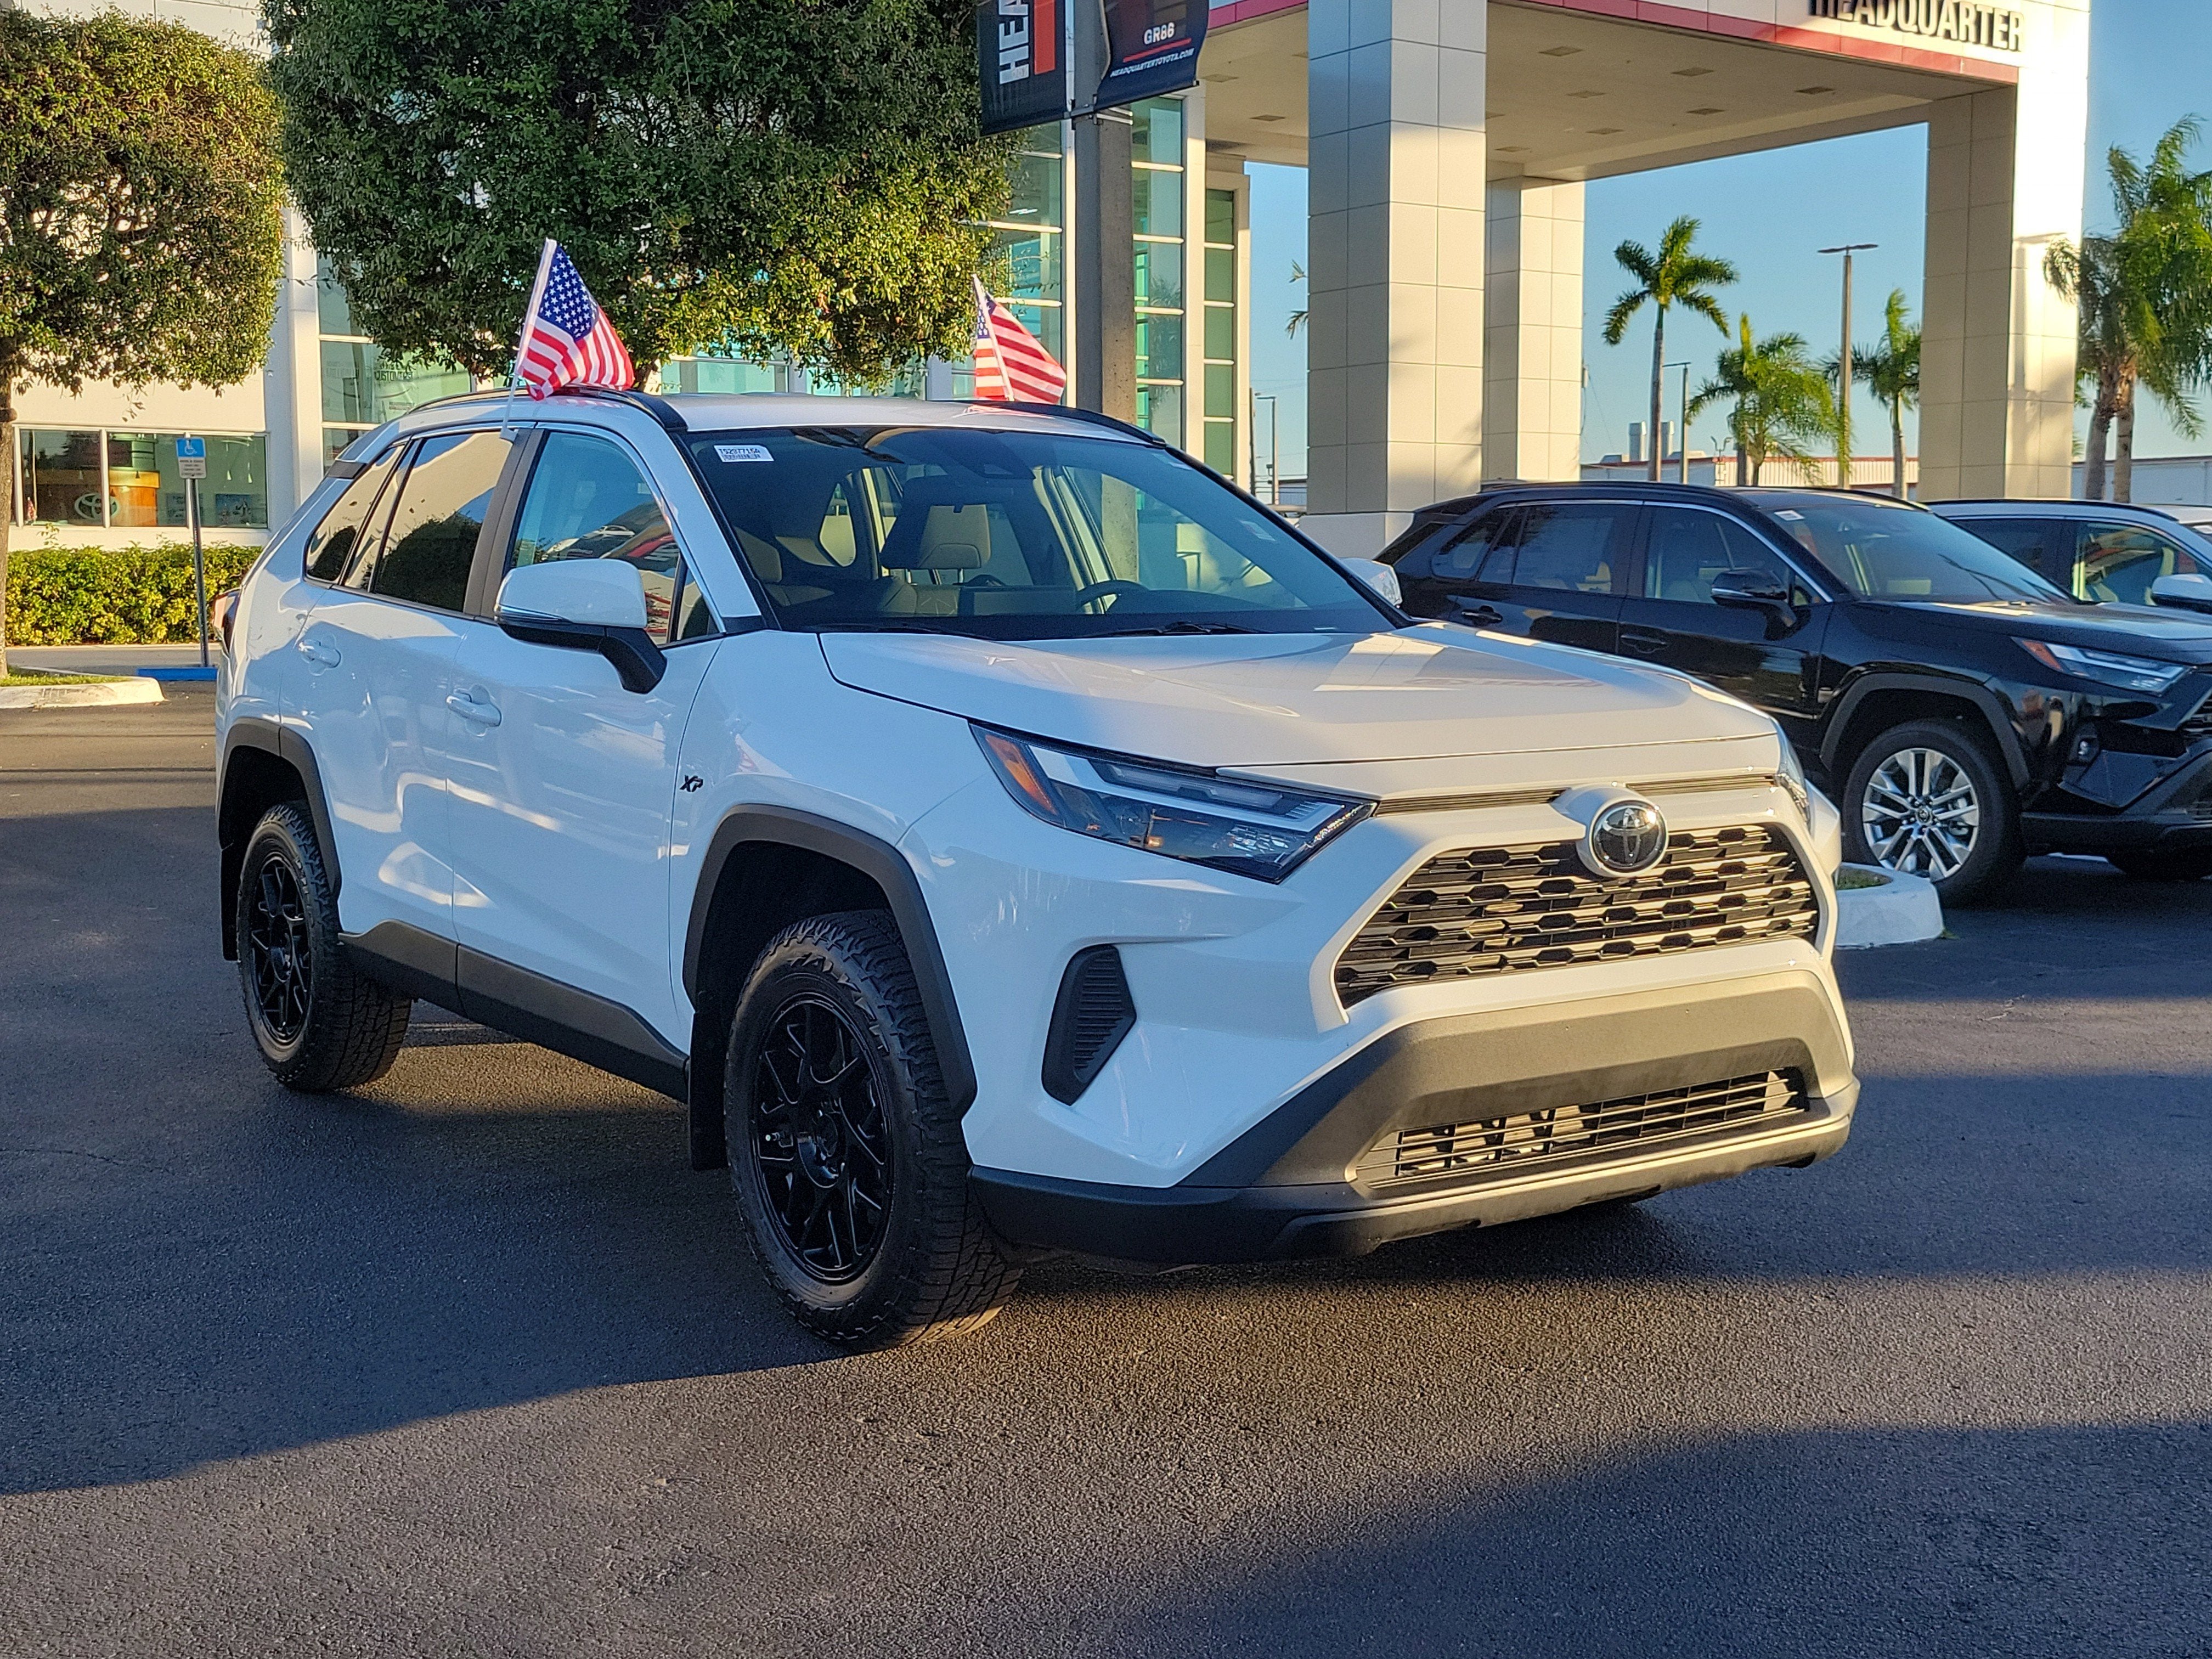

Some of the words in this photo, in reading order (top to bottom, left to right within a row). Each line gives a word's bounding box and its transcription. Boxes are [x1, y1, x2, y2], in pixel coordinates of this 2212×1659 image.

[1144, 21, 1175, 44] GR86
[1110, 48, 1194, 77] HEADQUARTERTOYOTA.COM
[679, 775, 703, 793] XP
